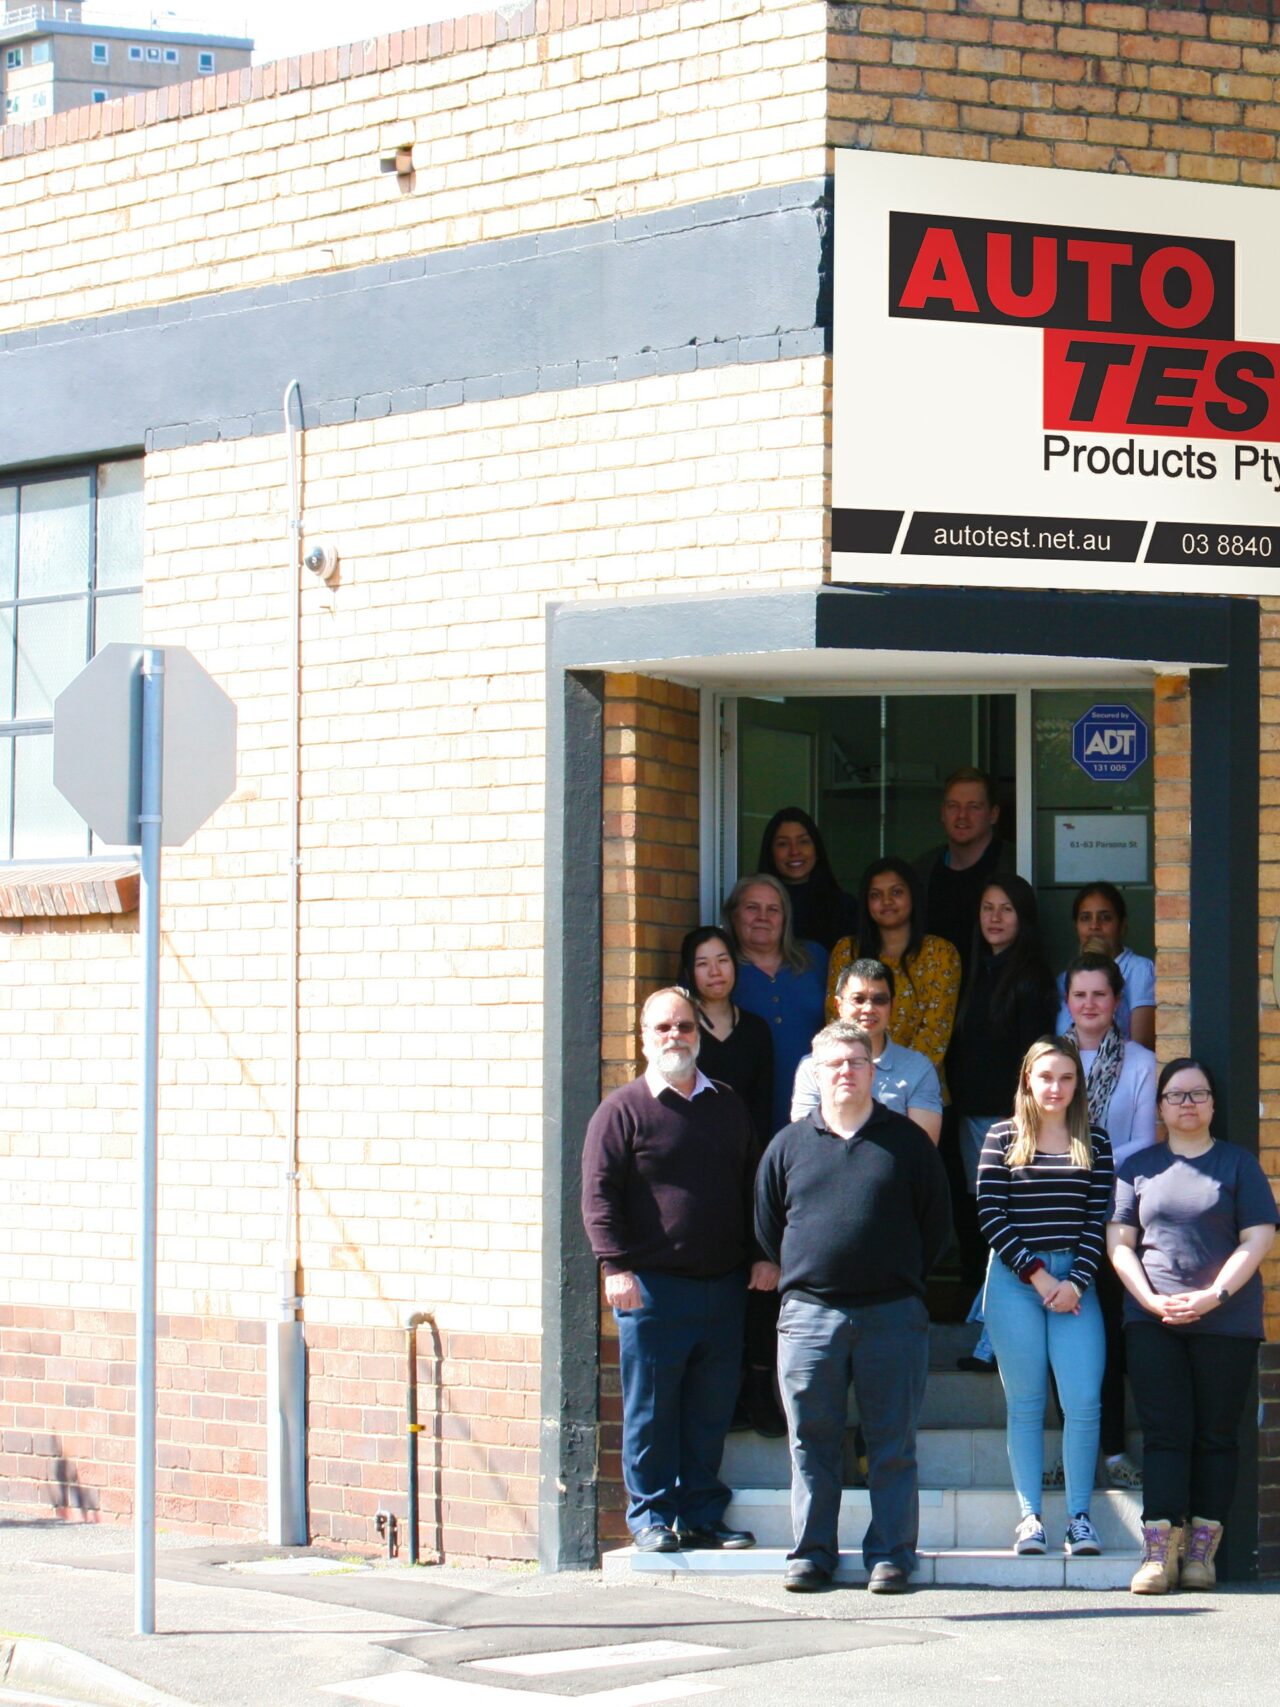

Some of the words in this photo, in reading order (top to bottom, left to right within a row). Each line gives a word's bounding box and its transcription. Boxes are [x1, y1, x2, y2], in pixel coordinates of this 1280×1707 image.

[898, 227, 1215, 330] AUTO
[1043, 435, 1217, 479] Products
[933, 524, 1111, 551] autotest.net.au
[1182, 533, 1209, 555] 03
[1217, 534, 1272, 557] 8840
[1121, 711, 1129, 720] by
[1085, 729, 1136, 755] ADT
[1093, 764, 1107, 772] 131
[1110, 764, 1127, 772] 005
